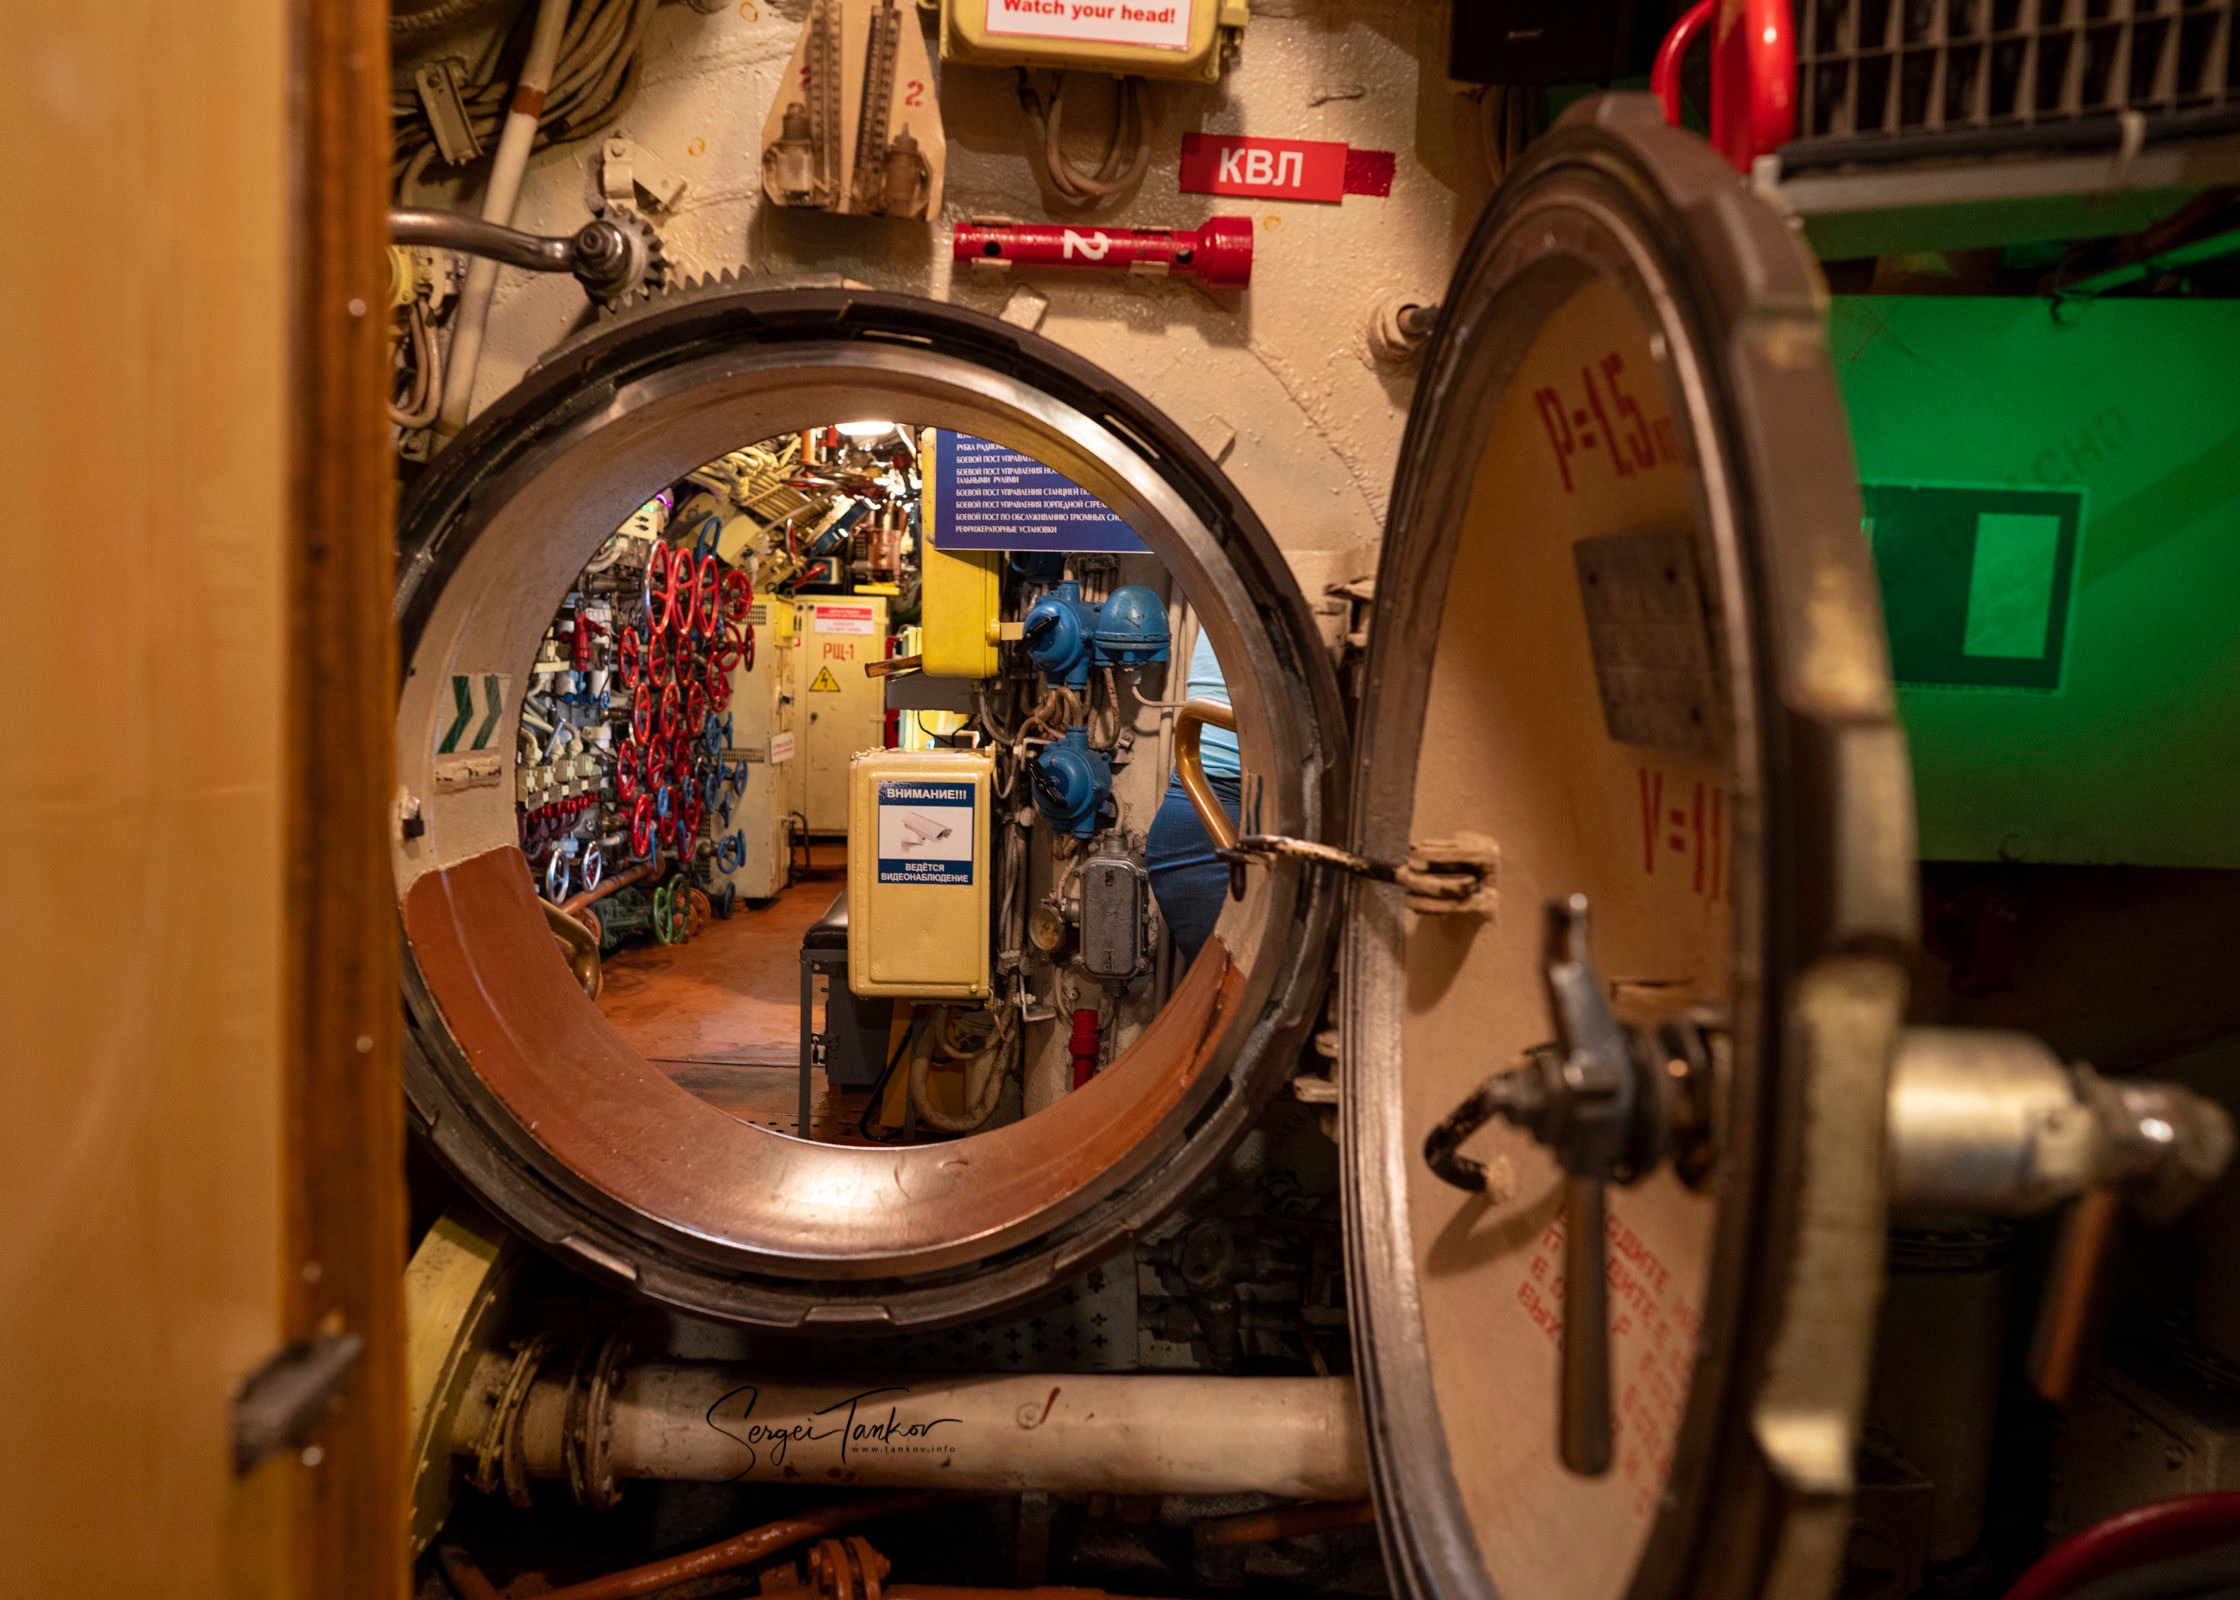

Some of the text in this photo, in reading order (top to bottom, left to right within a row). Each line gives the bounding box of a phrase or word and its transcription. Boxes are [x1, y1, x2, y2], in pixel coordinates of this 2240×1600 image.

[1003, 0, 1176, 23] Watch your head!
[904, 80, 924, 107] 2
[1218, 147, 1304, 189] КВЛ
[1062, 228, 1110, 262] 2
[956, 454, 982, 463] БОЕВОЙ
[983, 455, 1000, 463] ПОСТ
[956, 466, 982, 476] БОЕВОЙ
[983, 467, 1000, 475] ПОСТ
[1001, 467, 1043, 475] УПРАВЛЕНИЯ
[956, 476, 1020, 484] ТАЛЬНЫМИ РУЛЯМИ
[956, 487, 982, 496] БОЕВОЙ
[982, 488, 1000, 496] ПОСТ
[1001, 488, 1042, 496] УПРАВЛЕНИЯ
[1043, 487, 1079, 497] СТАНЦИЕЙ
[955, 500, 981, 508] БОЕВОЙ
[1001, 500, 1042, 508] УПРАВЛЕНИЯ
[1043, 500, 1083, 510] ТОРПЕДНОЙ
[955, 512, 981, 521] БОЕВОЙ
[982, 513, 999, 521] ПОСТ
[1000, 513, 1010, 521] ПО
[1011, 513, 1069, 521] ОБСЛУЖИВАНИЮ
[1070, 513, 1107, 521] ТРЮМНЫХ
[955, 525, 1017, 533] РЕФРИЖЕРАТОРНЫЕ
[823, 641, 854, 662] РЩ-1
[887, 788, 967, 799] ВНИМАНИЕ!!!
[905, 862, 945, 872] ВЕДЁТСЯ
[881, 872, 968, 882] ВИДЕОНАБЛЮДЕНИЕ
